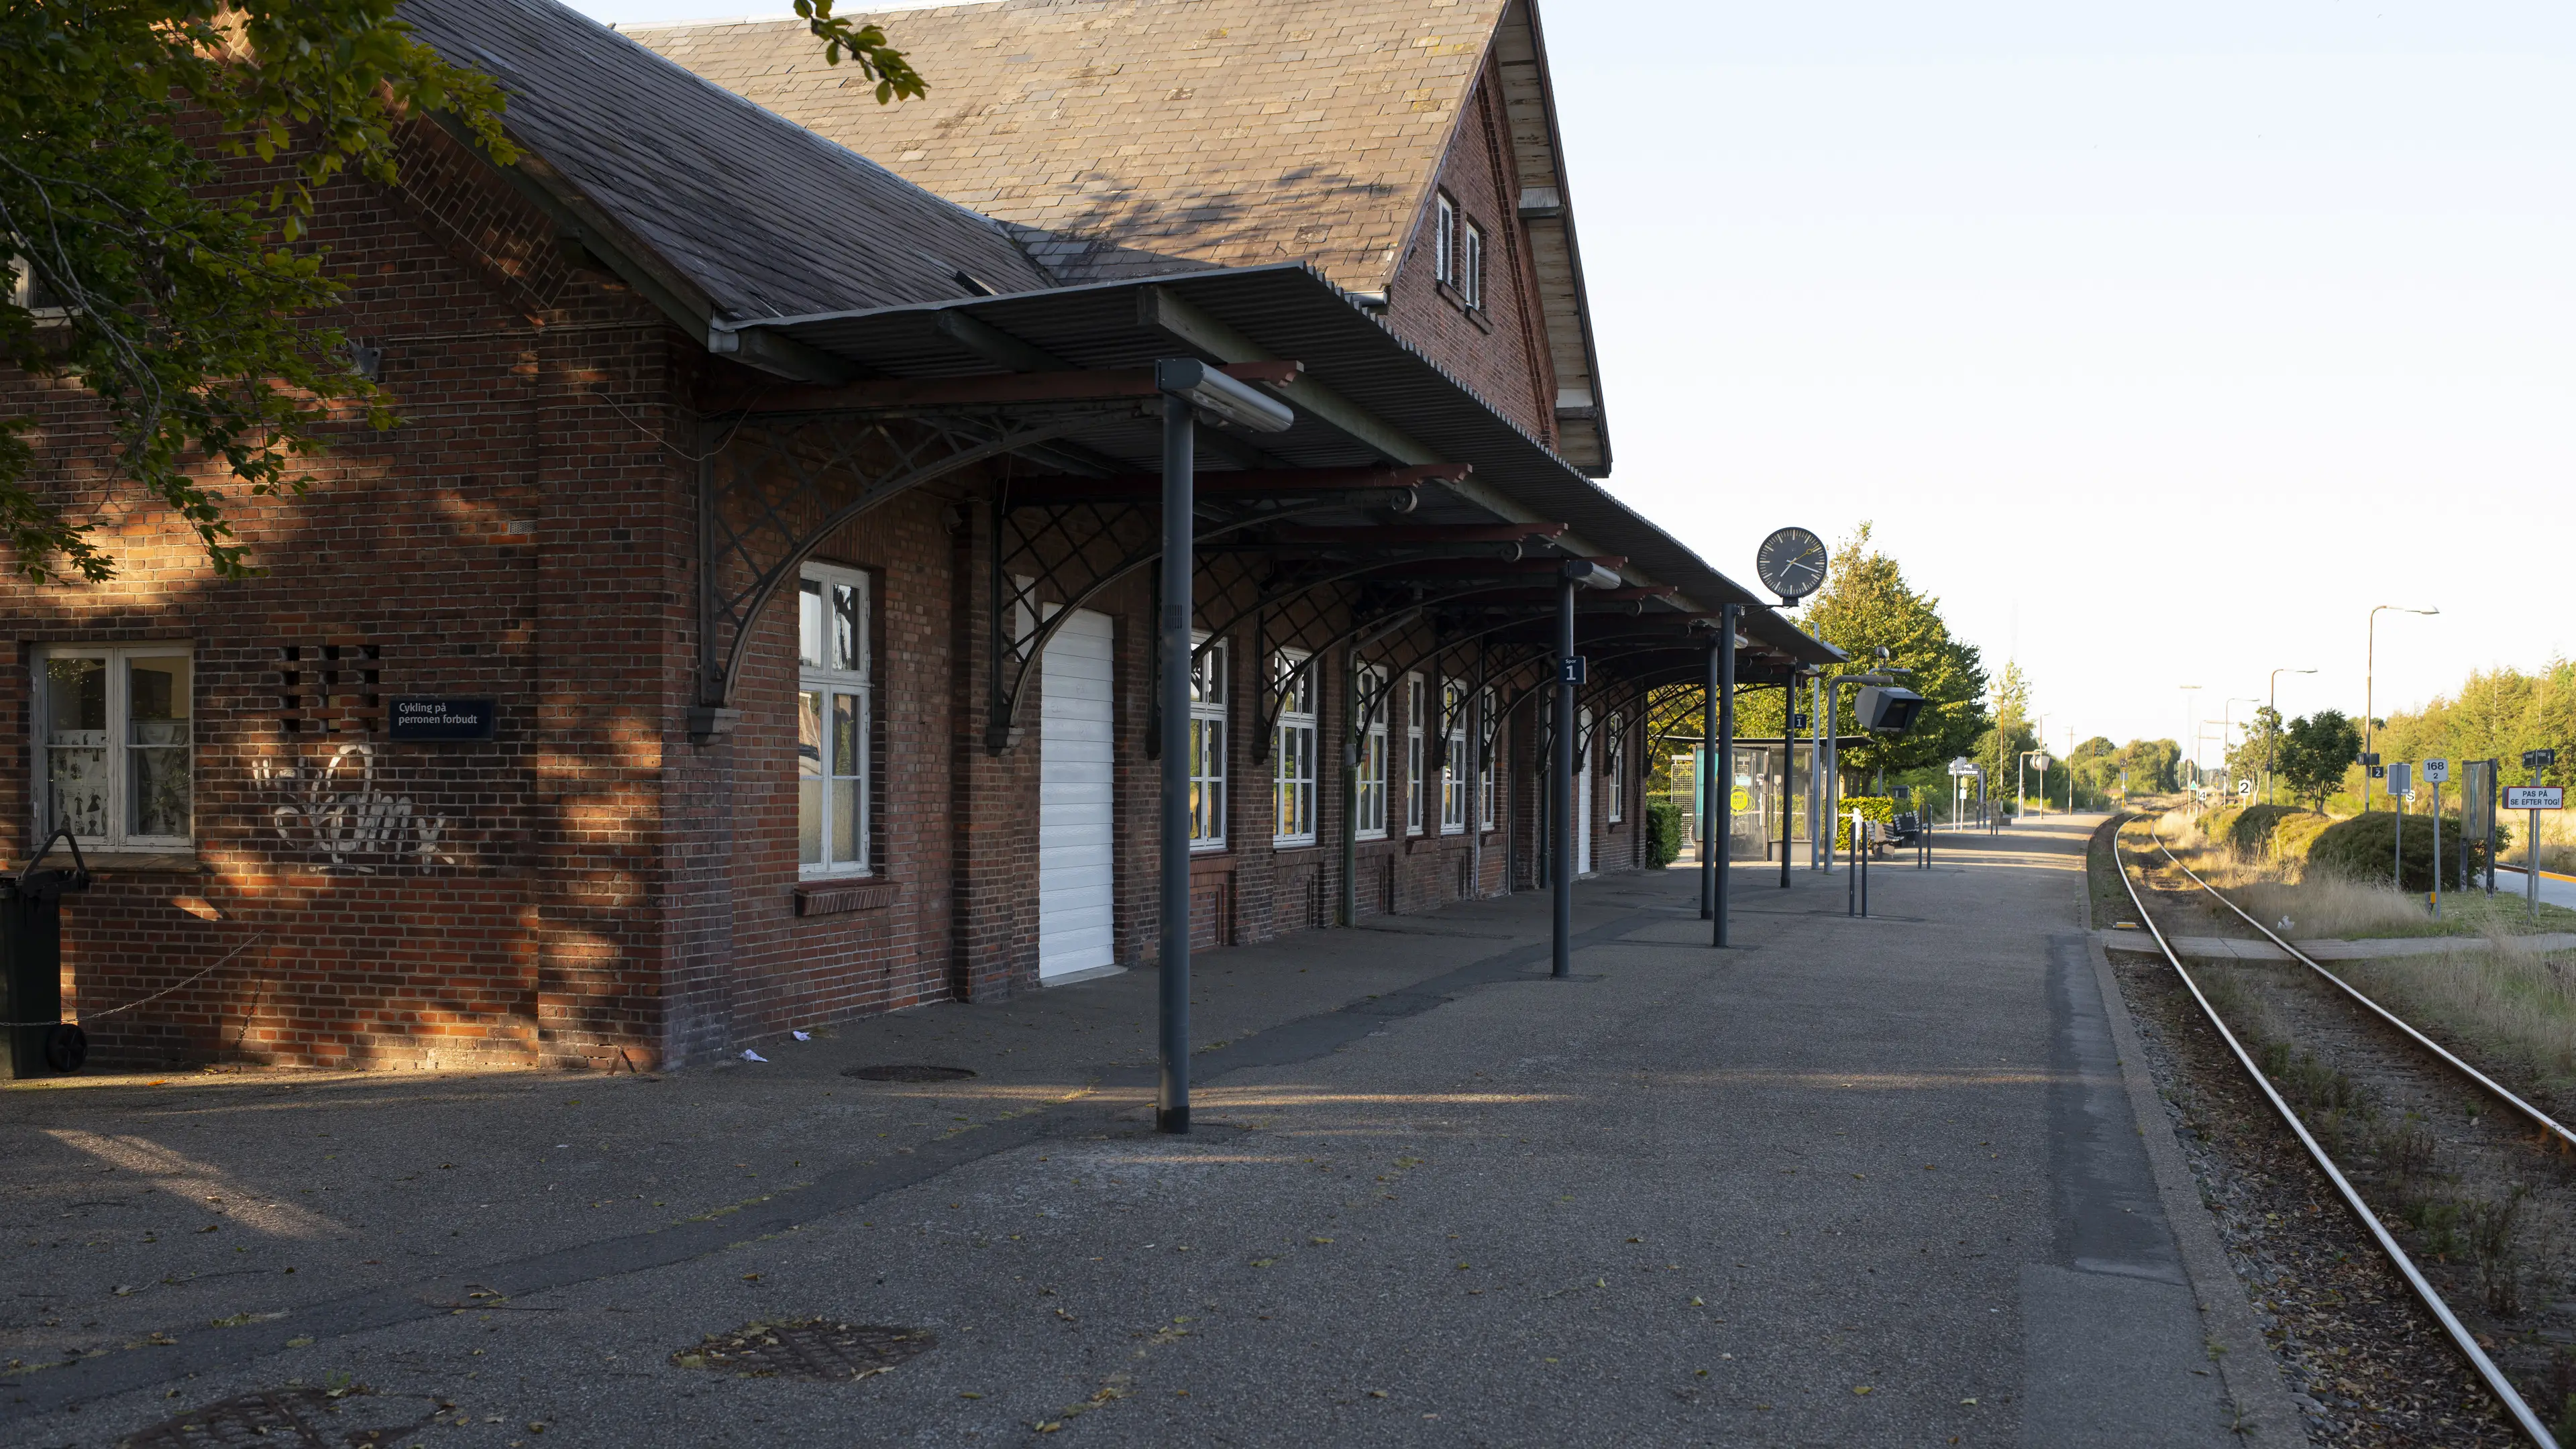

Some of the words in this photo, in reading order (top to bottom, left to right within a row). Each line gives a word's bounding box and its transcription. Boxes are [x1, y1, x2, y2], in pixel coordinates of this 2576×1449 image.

[1566, 665, 1576, 680] 1
[399, 702, 432, 714] Cykling
[435, 702, 446, 714] på
[398, 714, 440, 726] perronen
[443, 714, 478, 724] forbudt
[1796, 718, 1802, 727] 1
[2426, 761, 2444, 770] 168
[2240, 782, 2249, 794] 2
[2407, 792, 2414, 800] S
